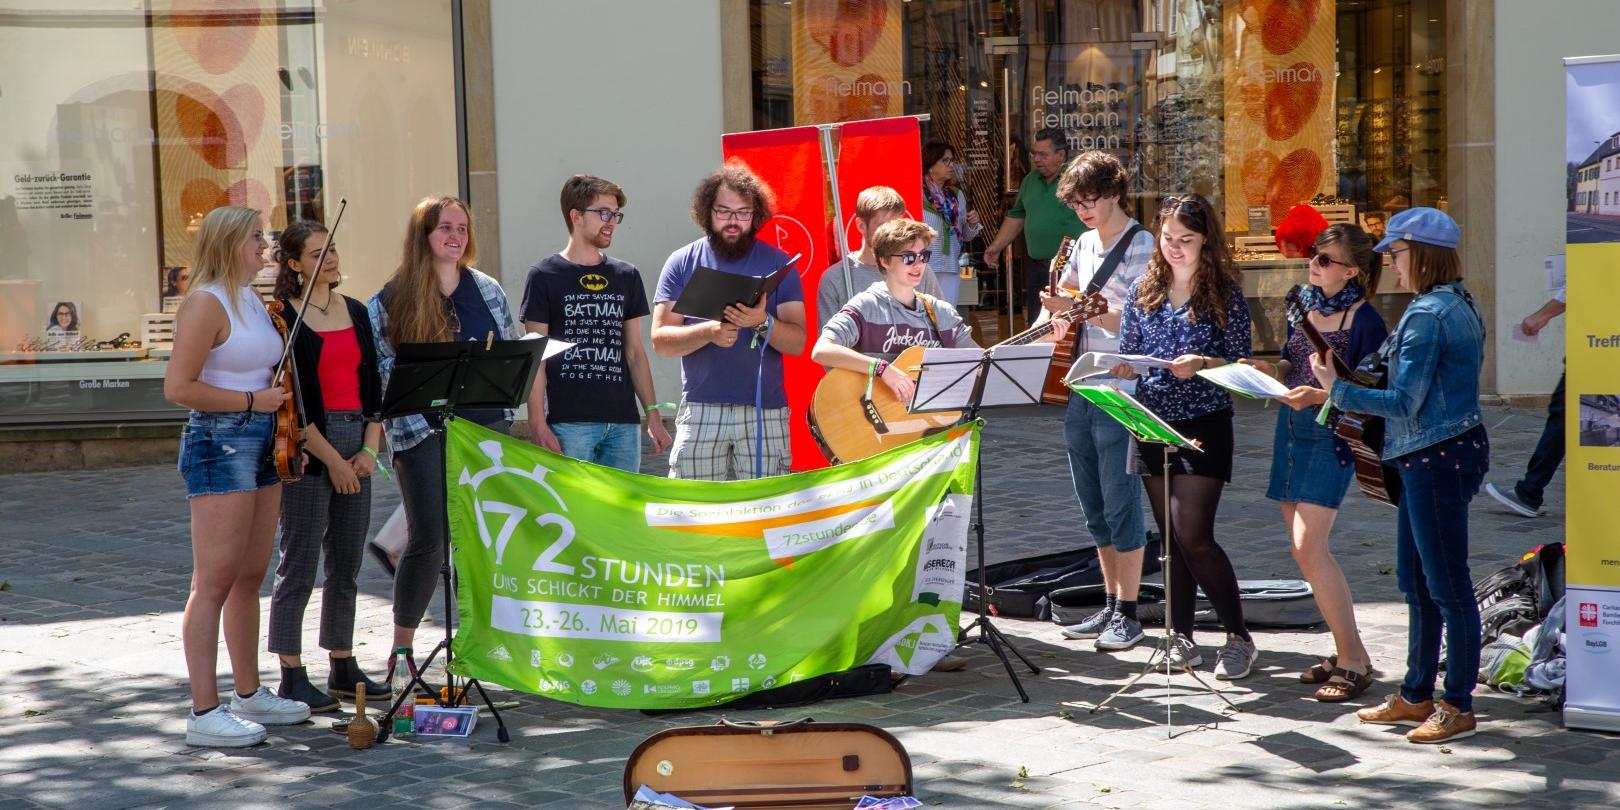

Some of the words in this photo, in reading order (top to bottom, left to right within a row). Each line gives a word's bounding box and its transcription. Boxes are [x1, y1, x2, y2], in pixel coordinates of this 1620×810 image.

[1034, 133, 1120, 151] mann
[14, 172, 92, 183] Geld-zurück-Garantie
[592, 293, 615, 301] SAYING
[564, 302, 624, 318] BATMAN
[602, 319, 623, 328] SAYING
[592, 328, 606, 336] HAS
[592, 337, 605, 345] ME
[564, 346, 622, 363] BATMAN
[590, 364, 607, 372] SAME
[79, 379, 100, 389] Große
[102, 378, 130, 388] Marken
[657, 506, 682, 518] Die
[689, 504, 782, 518] Sozialaktion
[877, 442, 963, 486] Deutschand
[782, 513, 878, 547] 72stundee
[481, 500, 576, 576] 72
[581, 556, 725, 588] STUNDEN
[924, 558, 956, 572] SEREOR
[527, 578, 602, 600] SCHICKT
[612, 589, 647, 605] DER
[657, 593, 725, 607] HIMMEL
[600, 614, 637, 634] Mai
[646, 617, 698, 636] 2019
